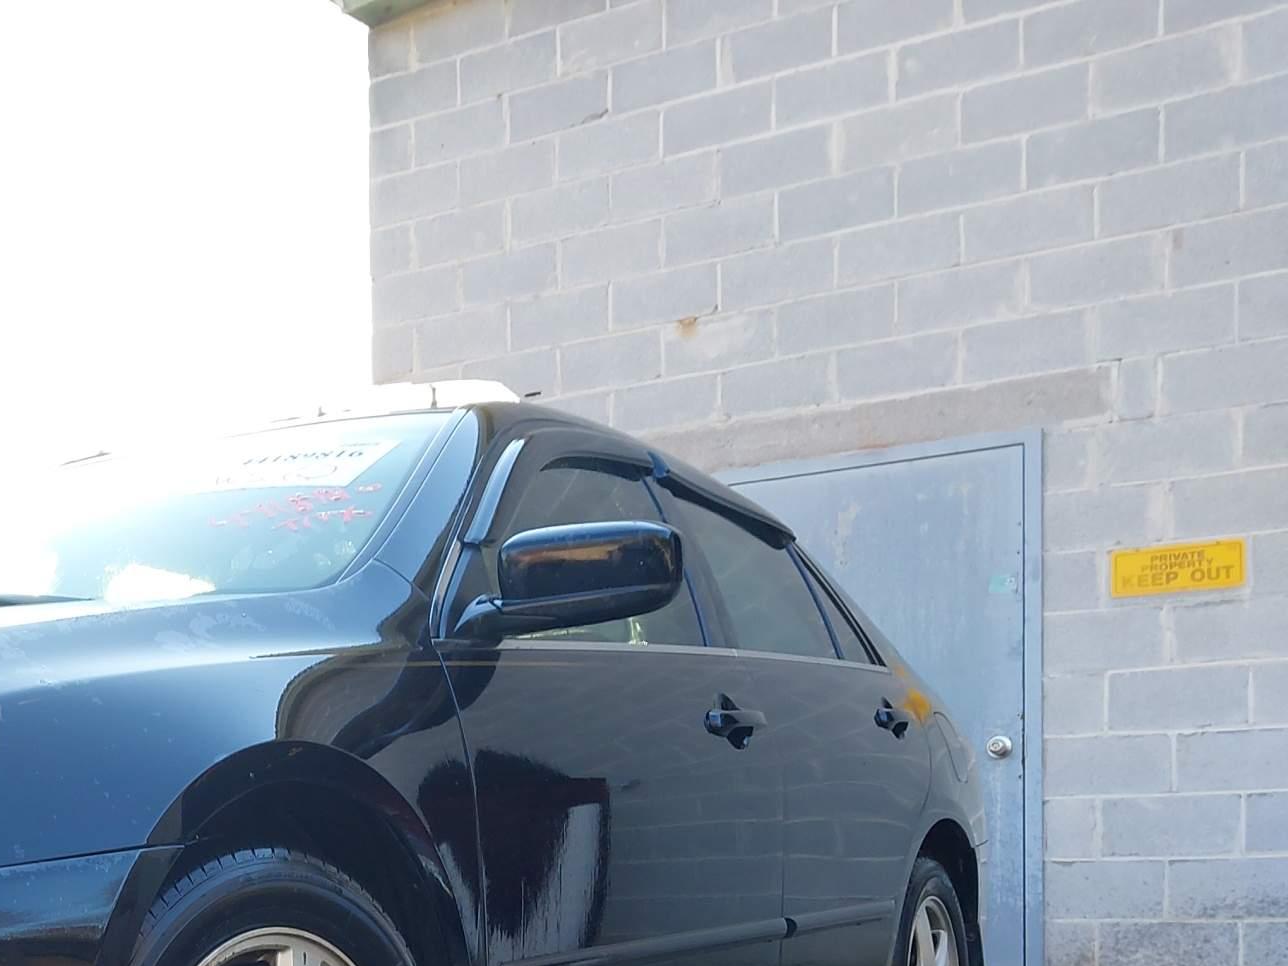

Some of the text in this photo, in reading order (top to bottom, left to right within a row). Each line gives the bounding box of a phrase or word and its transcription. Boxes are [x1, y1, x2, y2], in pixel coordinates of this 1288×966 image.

[1150, 550, 1206, 563] PRIVATE
[1141, 558, 1214, 572] PROPERTY
[1122, 565, 1235, 588] KEEP OUT
